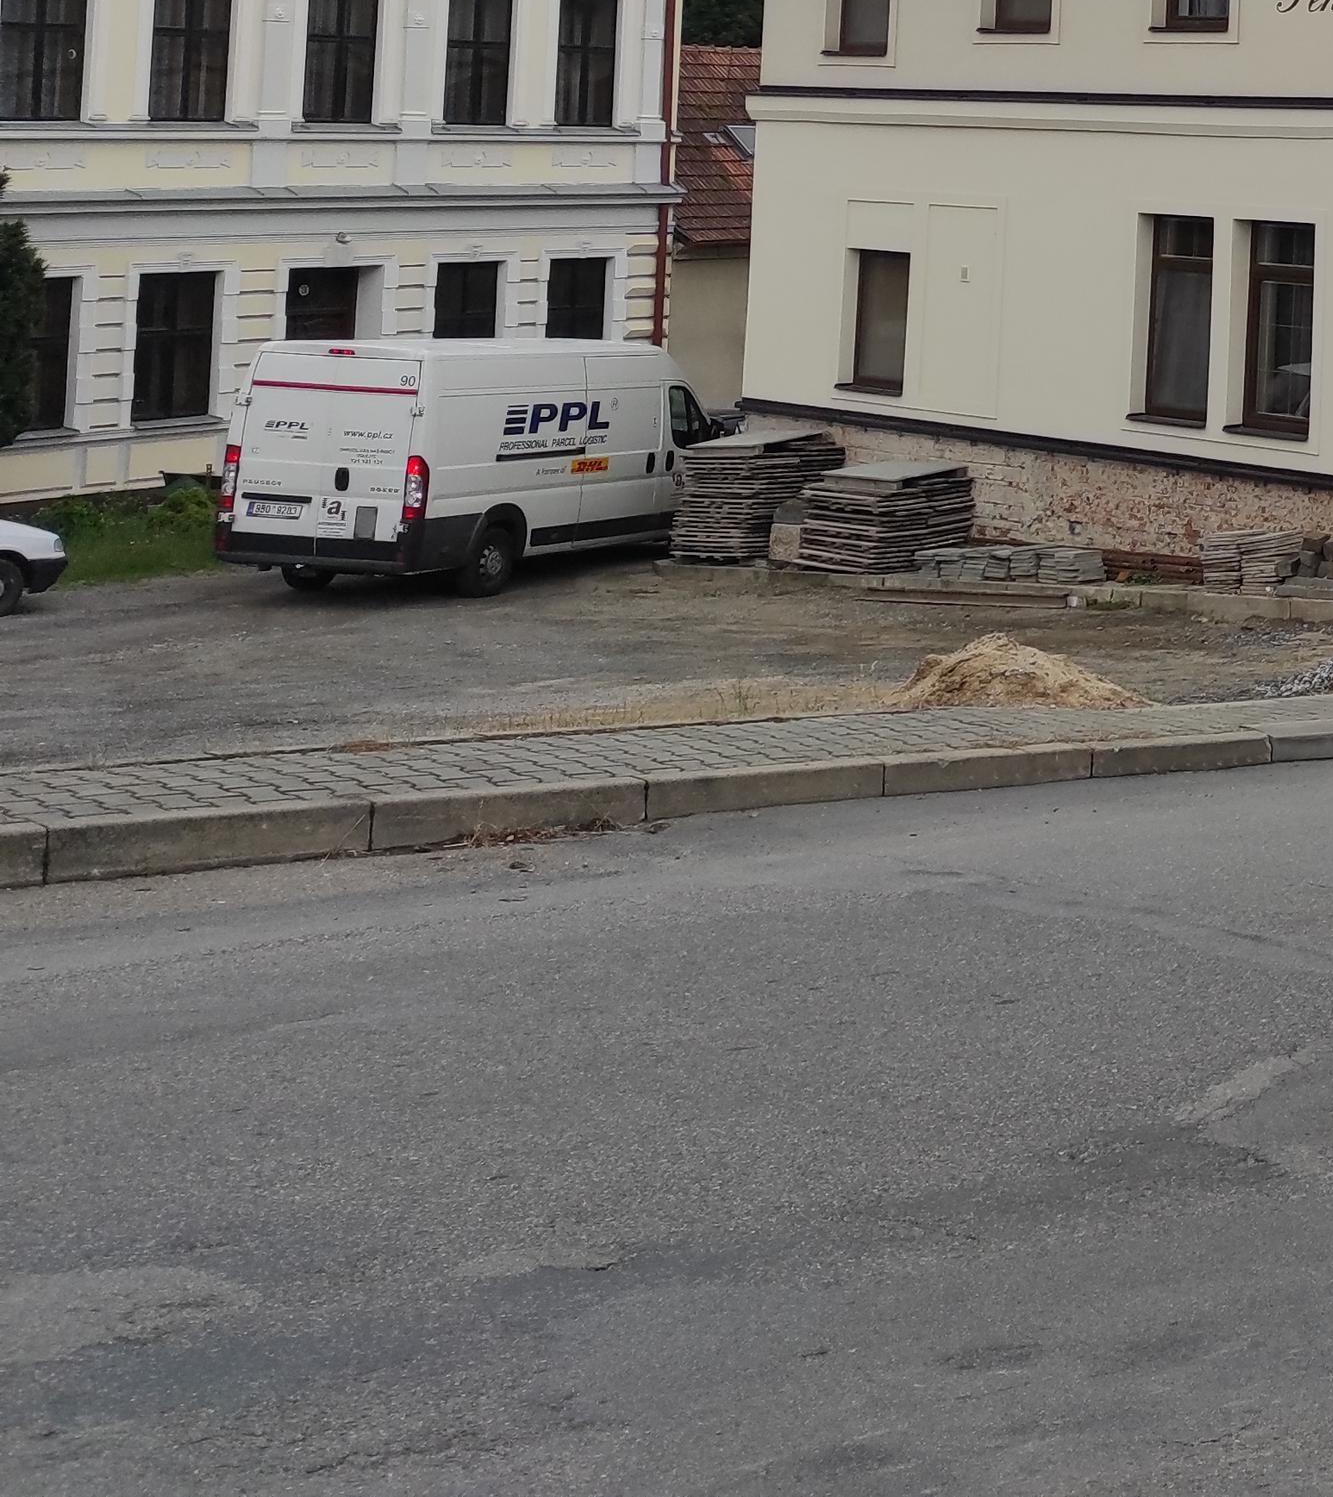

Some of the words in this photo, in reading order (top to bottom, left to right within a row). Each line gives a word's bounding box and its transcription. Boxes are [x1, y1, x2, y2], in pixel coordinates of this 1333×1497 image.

[399, 375, 416, 387] 90
[528, 401, 610, 434] PPL
[275, 420, 309, 430] PPL
[343, 430, 393, 440] www.ppl.cz
[498, 440, 549, 452] PROFESSIONAL
[551, 437, 577, 448] PARCEL
[578, 434, 608, 446] LOGISTIC
[575, 459, 607, 473] DHL
